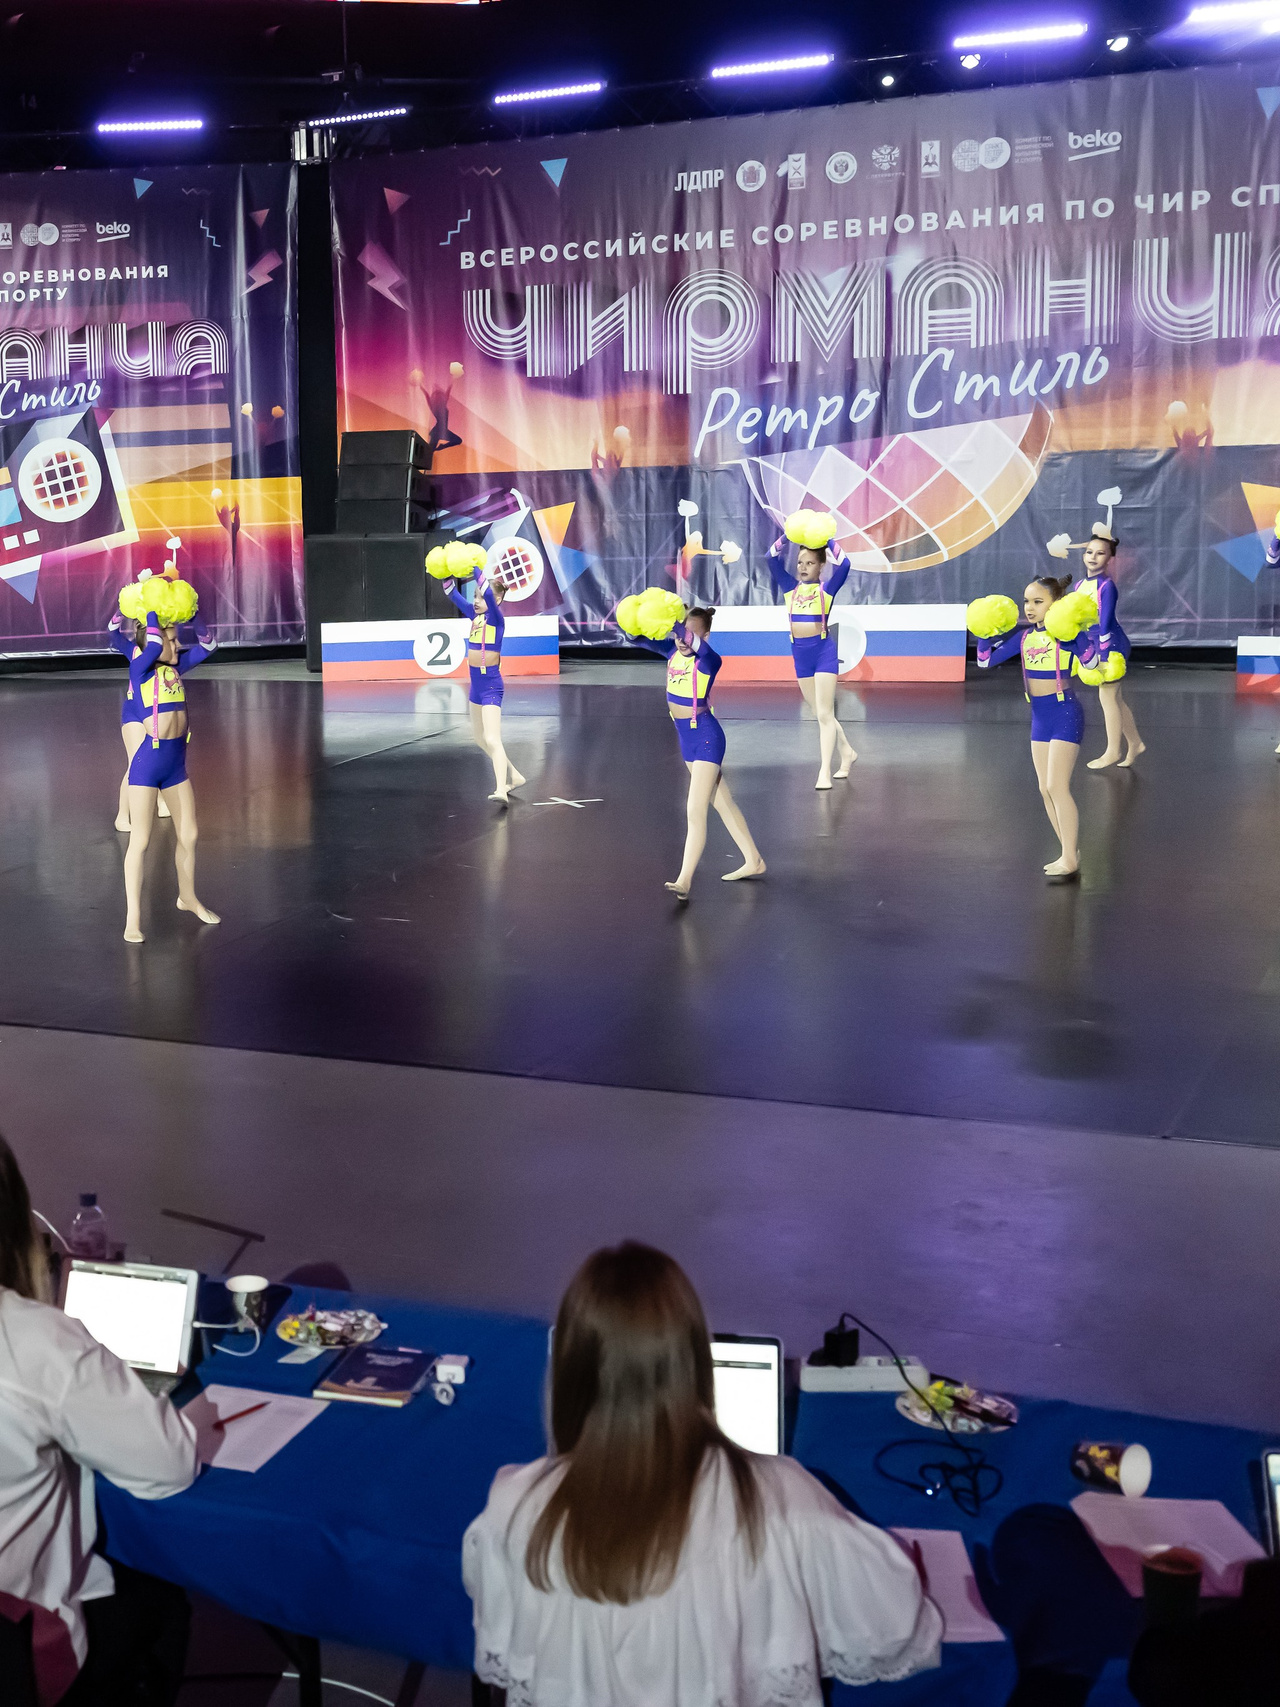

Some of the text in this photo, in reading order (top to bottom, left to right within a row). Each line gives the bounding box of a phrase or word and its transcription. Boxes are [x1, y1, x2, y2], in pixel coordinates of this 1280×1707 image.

[1068, 129, 1122, 149] beko
[674, 169, 725, 193] ЛДПР
[96, 221, 131, 235] beko
[460, 229, 735, 270] ВСЕРОССИЙСКИЕ
[752, 203, 1045, 245] СОРЕВНОВАНИЯ
[1065, 198, 1115, 220] ПО
[1134, 190, 1211, 214] ЧИР
[694, 346, 1109, 457] Ретро Стиль
[427, 632, 451, 666] 2
